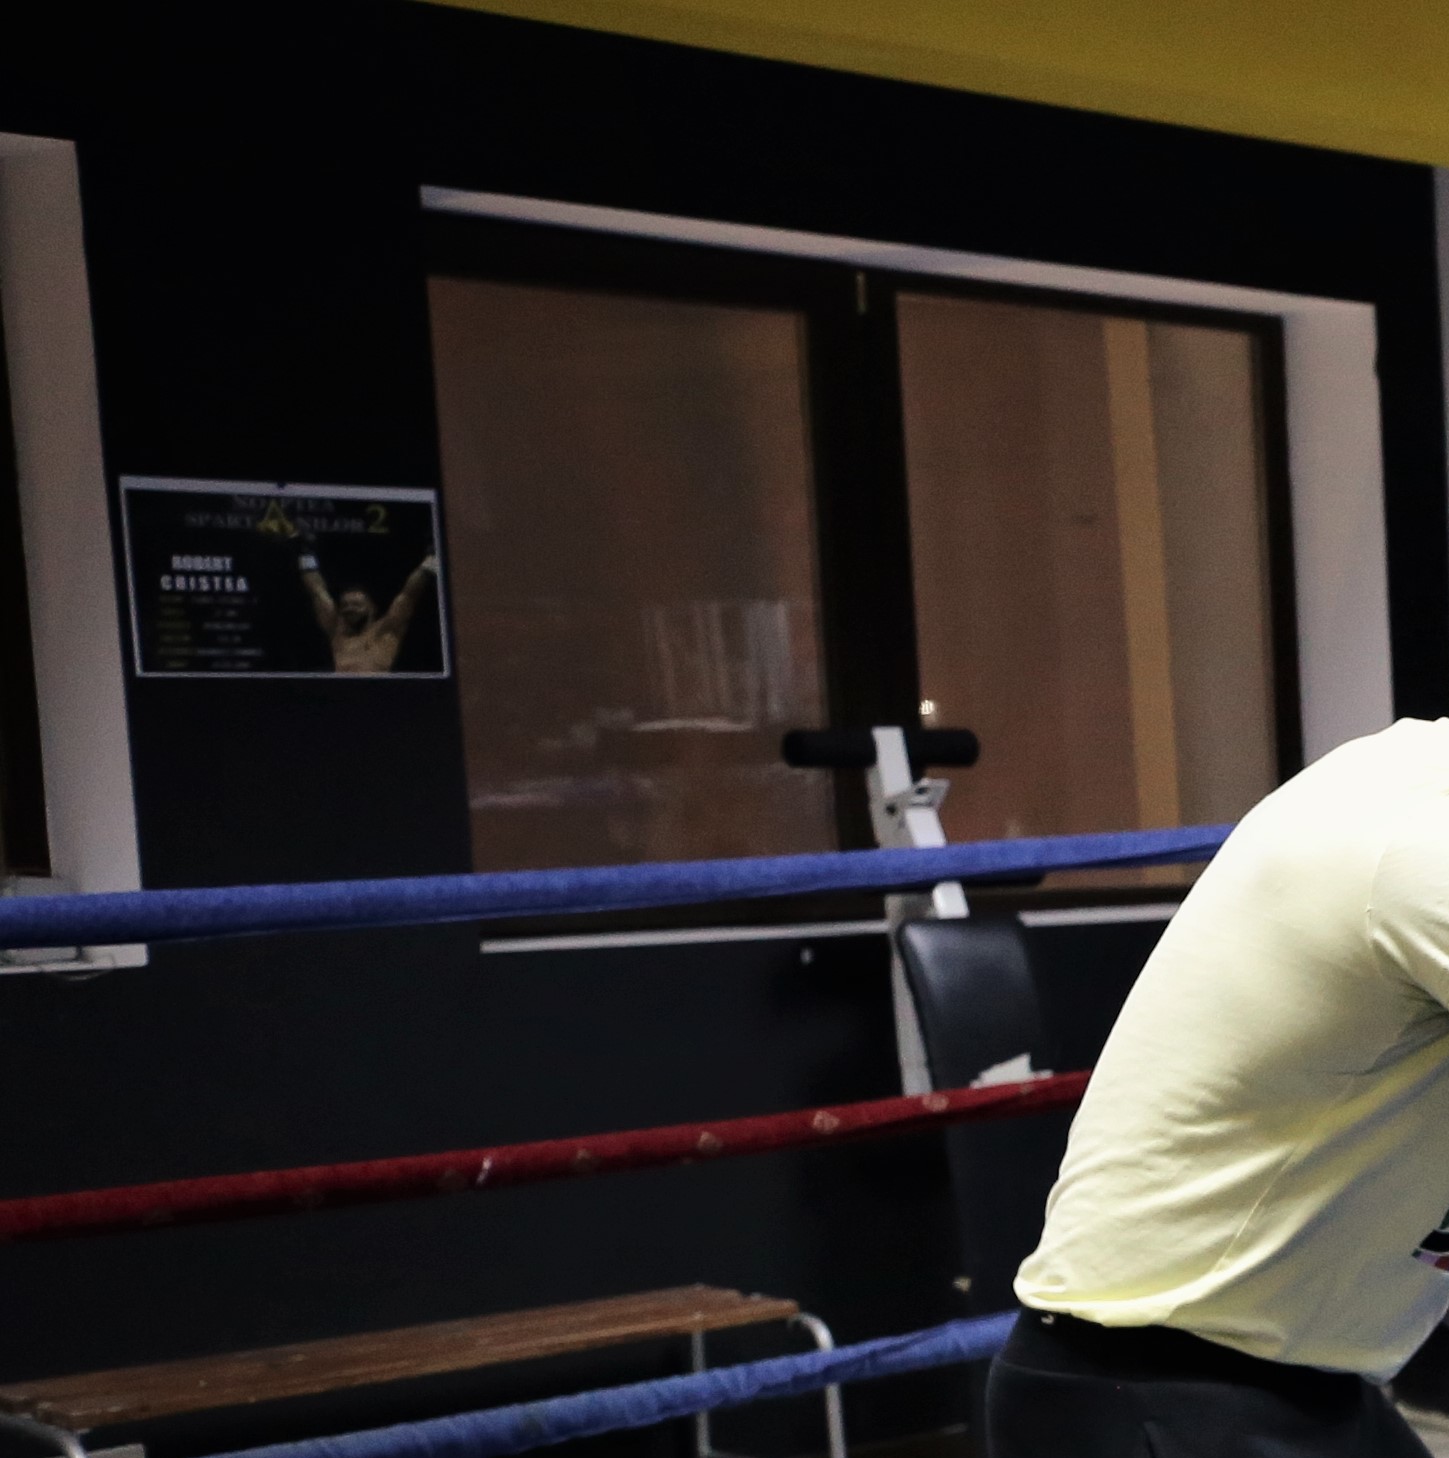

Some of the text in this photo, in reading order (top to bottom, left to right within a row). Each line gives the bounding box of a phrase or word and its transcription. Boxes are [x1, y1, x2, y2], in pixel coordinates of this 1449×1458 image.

[366, 503, 390, 534] 2
[171, 554, 233, 572] ROBERT
[160, 574, 249, 592] CRISTEA
